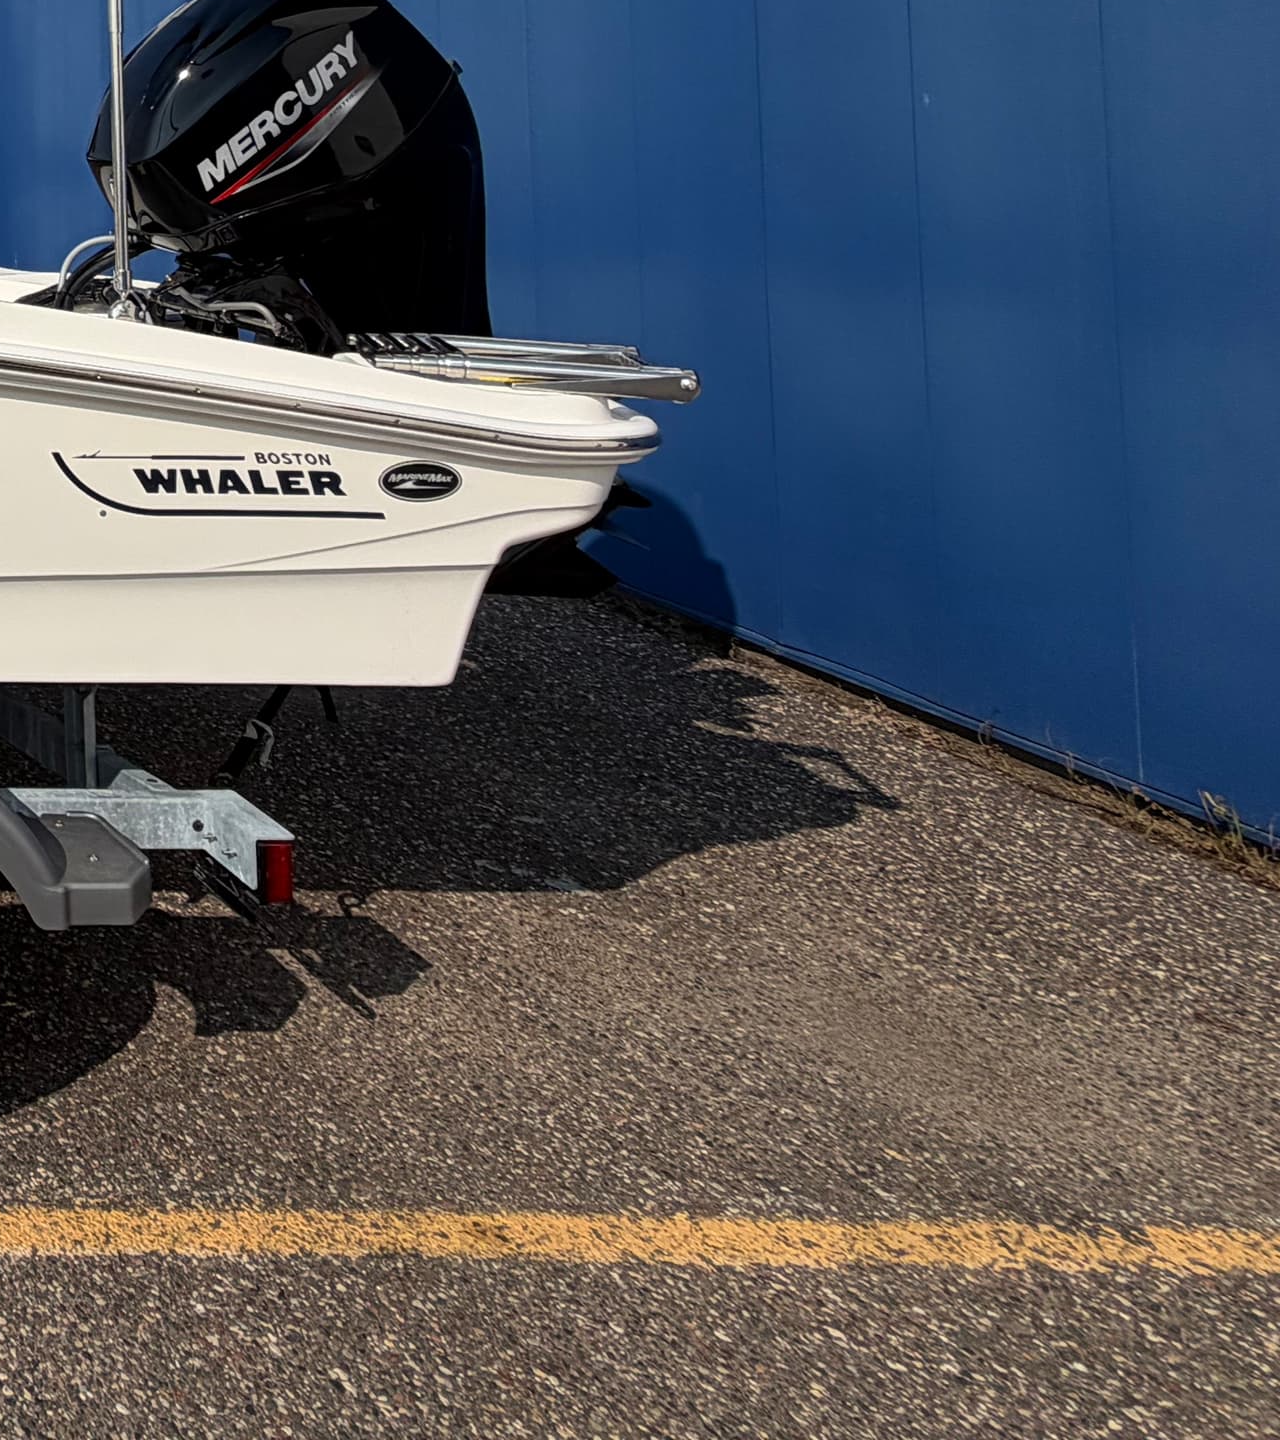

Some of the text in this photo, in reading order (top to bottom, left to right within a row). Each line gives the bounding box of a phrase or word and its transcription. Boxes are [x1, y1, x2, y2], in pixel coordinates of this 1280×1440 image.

[197, 30, 358, 192] MERCURY
[254, 452, 332, 466] BOSTON
[133, 468, 347, 496] WHALER
